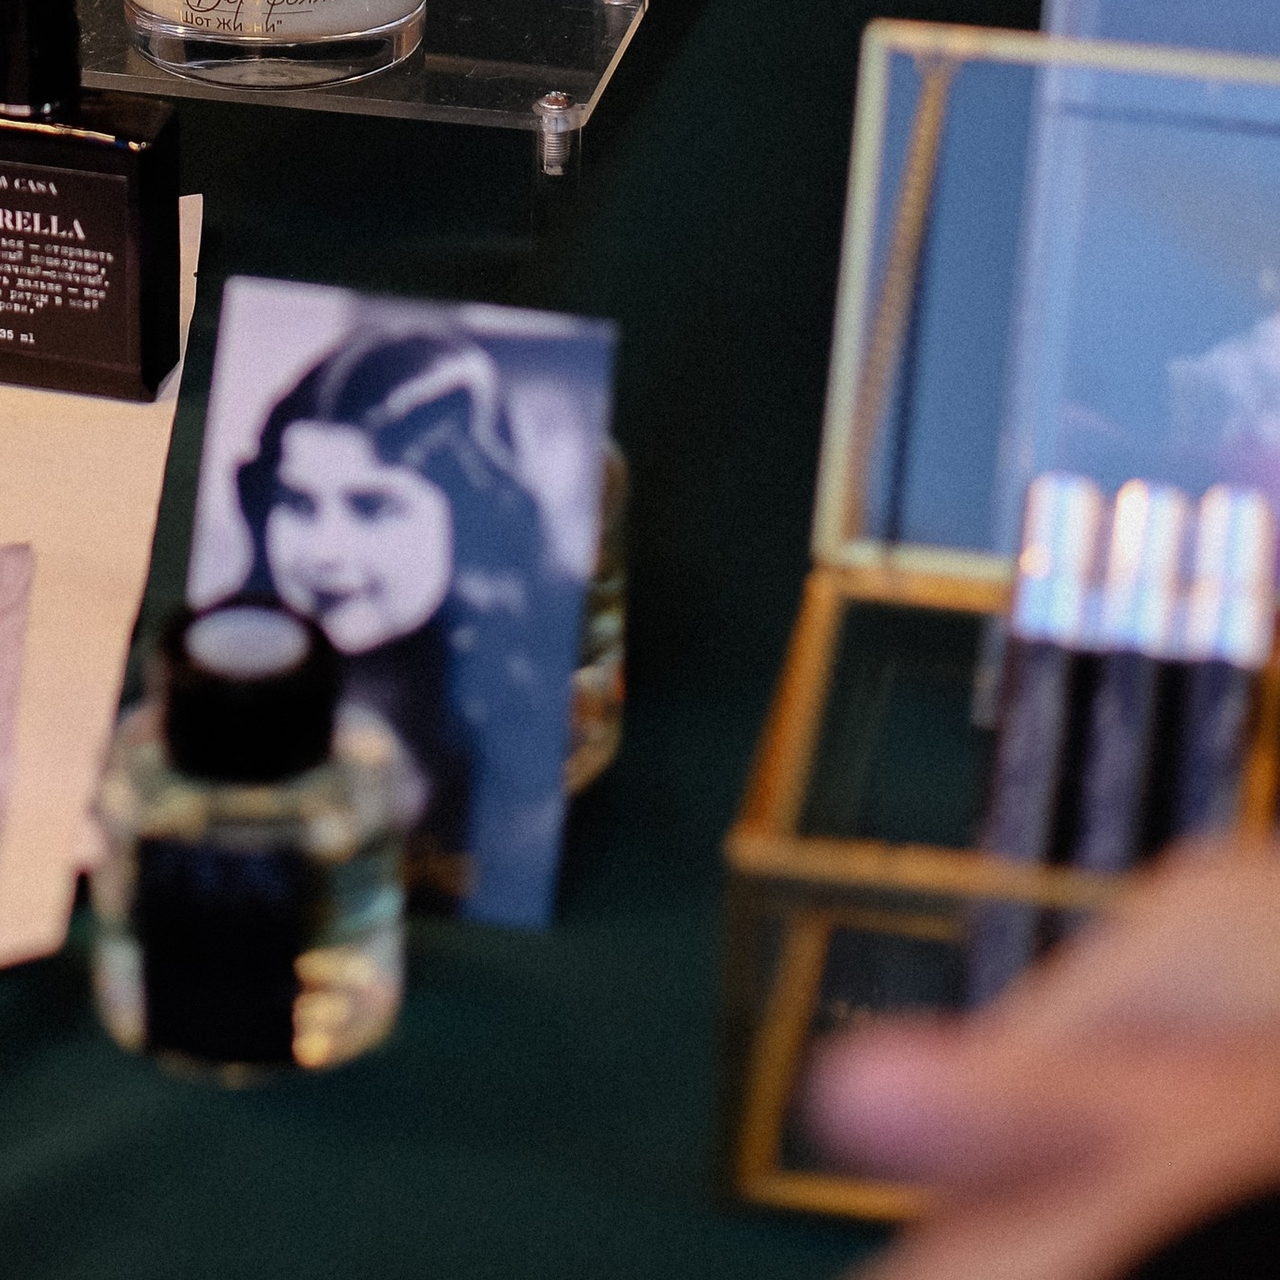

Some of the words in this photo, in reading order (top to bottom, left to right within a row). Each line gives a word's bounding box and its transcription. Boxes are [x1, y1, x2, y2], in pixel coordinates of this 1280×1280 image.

[14, 178, 58, 196] CASA
[16, 277, 62, 292] дальше
[83, 287, 106, 299] все
[9, 289, 49, 304] ритмы
[54, 295, 62, 306] в
[0, 328, 14, 340] 35
[20, 332, 35, 344] ml
